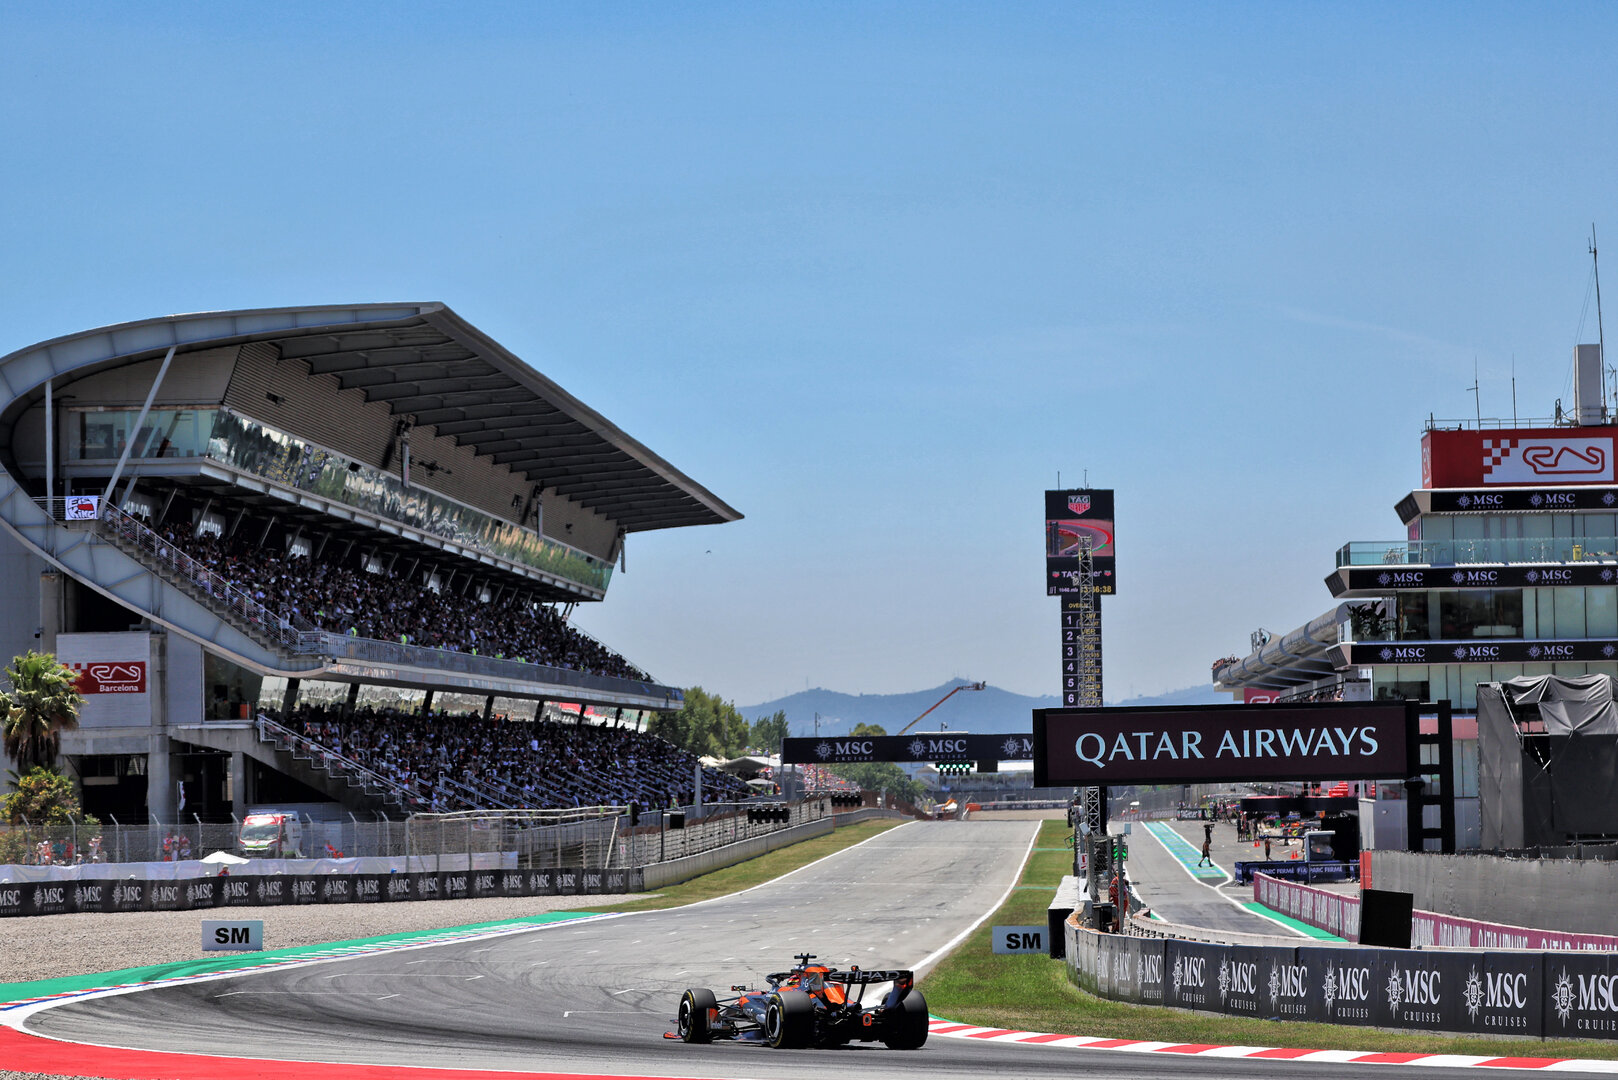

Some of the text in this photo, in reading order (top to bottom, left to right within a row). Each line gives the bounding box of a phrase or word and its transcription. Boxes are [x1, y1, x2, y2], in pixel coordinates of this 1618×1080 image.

[1473, 494, 1503, 504] MSC
[1545, 494, 1575, 504] MSC
[1394, 572, 1423, 582] MSC
[1467, 571, 1497, 581] MSC
[1542, 570, 1571, 580] MSC
[1067, 616, 1072, 624] 1
[1066, 632, 1073, 640] 2
[1067, 647, 1073, 656] 3
[1396, 648, 1425, 658] MSC
[1470, 647, 1499, 657] MSC
[1544, 646, 1574, 656] MSC
[1067, 663, 1074, 672] 4
[1068, 678, 1074, 687] 5
[1068, 694, 1074, 703] 6
[836, 741, 873, 755] MSC
[929, 740, 966, 752] MSC
[1075, 726, 1378, 768] QATAR AIRWAYS
[195, 884, 213, 899] MSC
[231, 882, 248, 896] MSC
[266, 882, 282, 896] MSC
[300, 881, 316, 895] MSC
[333, 881, 348, 894] MSC
[364, 880, 379, 894] MSC
[395, 879, 410, 892] MSC
[44, 888, 64, 903] MSC
[83, 886, 102, 901] MSC
[123, 886, 141, 901] MSC
[160, 887, 178, 901] MSC
[215, 927, 250, 944] SM
[1006, 933, 1041, 949] SM
[1144, 954, 1161, 983] MSC
[1183, 956, 1205, 988] MSC
[829, 971, 899, 981] ETIHAD
[1231, 962, 1256, 994] MSC
[1280, 966, 1307, 998] MSC
[1338, 968, 1369, 1000] MSC
[1405, 970, 1440, 1005] MSC
[1486, 973, 1526, 1008] MSC
[1183, 993, 1205, 1003] CRUISES
[1578, 974, 1618, 1012] MSC
[1231, 999, 1256, 1010] CRUISES
[1280, 1004, 1306, 1014] CRUISES
[1338, 1008, 1368, 1018] CRUISES
[1404, 1011, 1440, 1022] CRUISES
[1485, 1016, 1527, 1027] CRUISES
